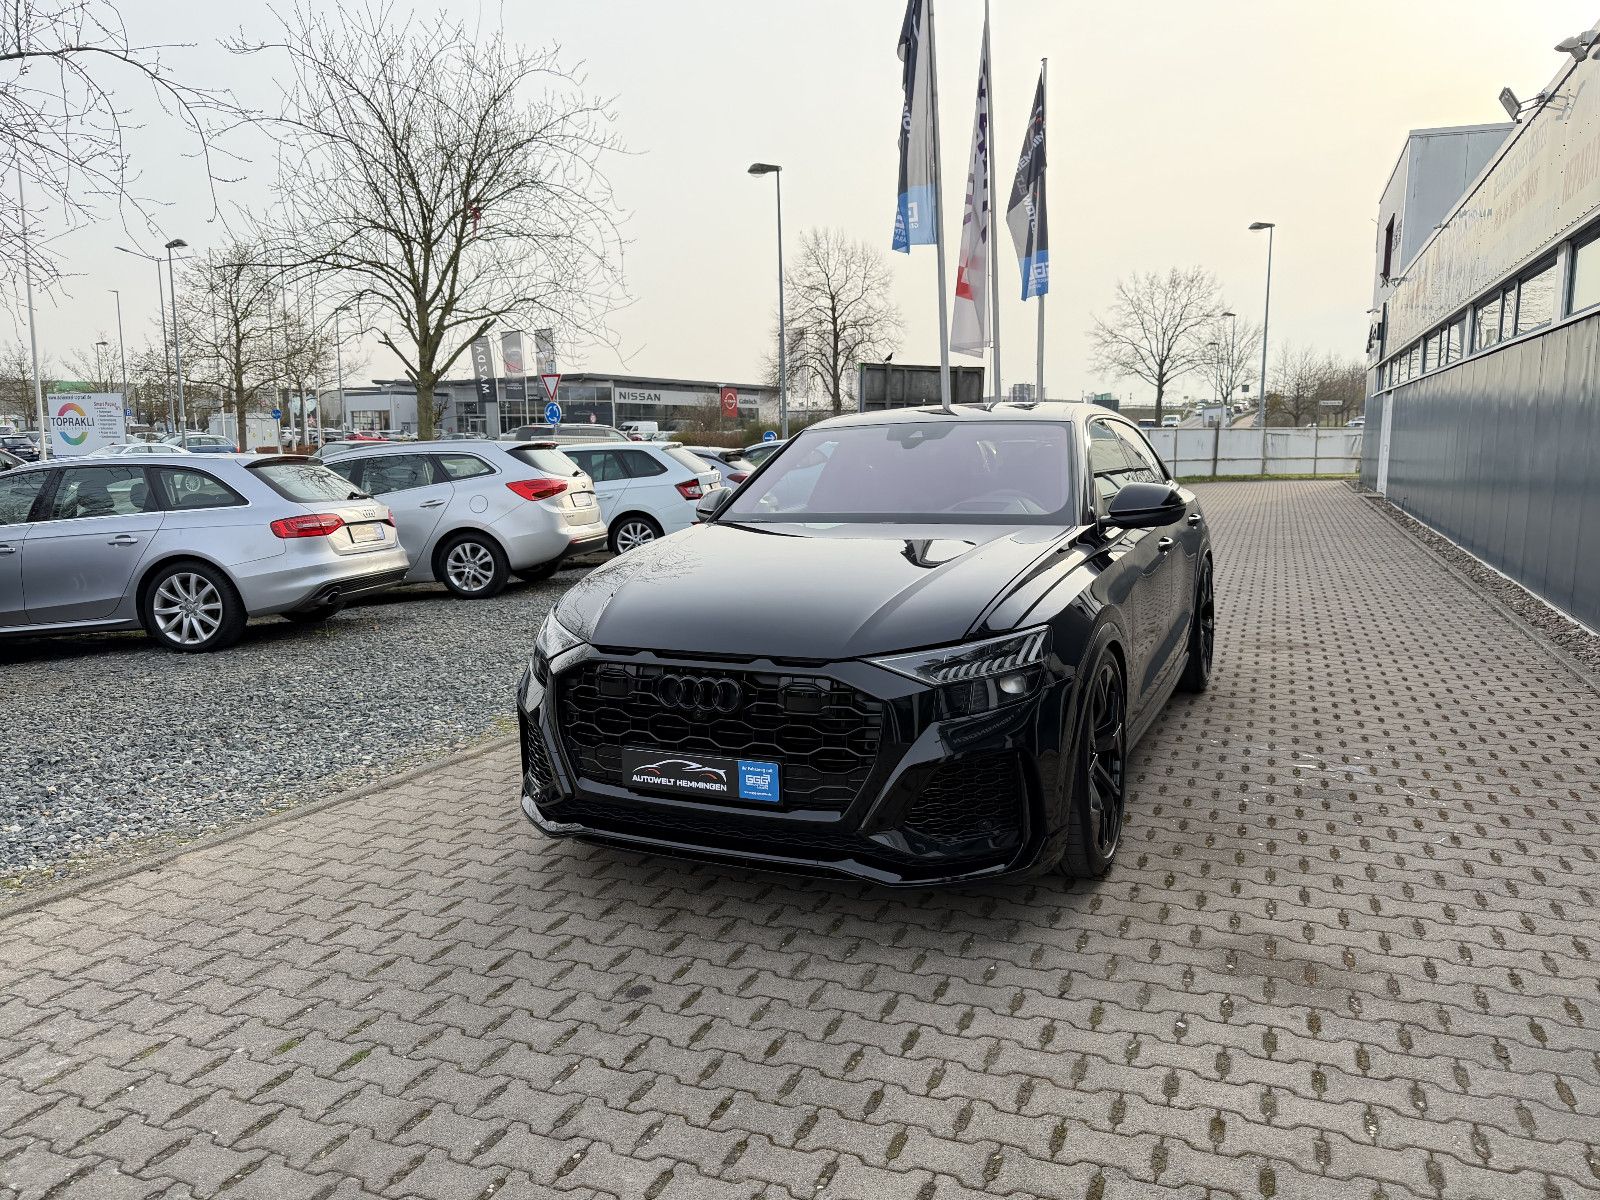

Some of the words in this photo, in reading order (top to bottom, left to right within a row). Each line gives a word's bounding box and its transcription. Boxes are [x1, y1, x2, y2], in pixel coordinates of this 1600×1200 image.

[619, 392, 661, 402] NISSAN
[51, 417, 95, 426] TOPRAKLI
[631, 774, 675, 786] AUTOWELT
[676, 780, 727, 792] HEMMINGEN
[745, 774, 770, 785] GGG
